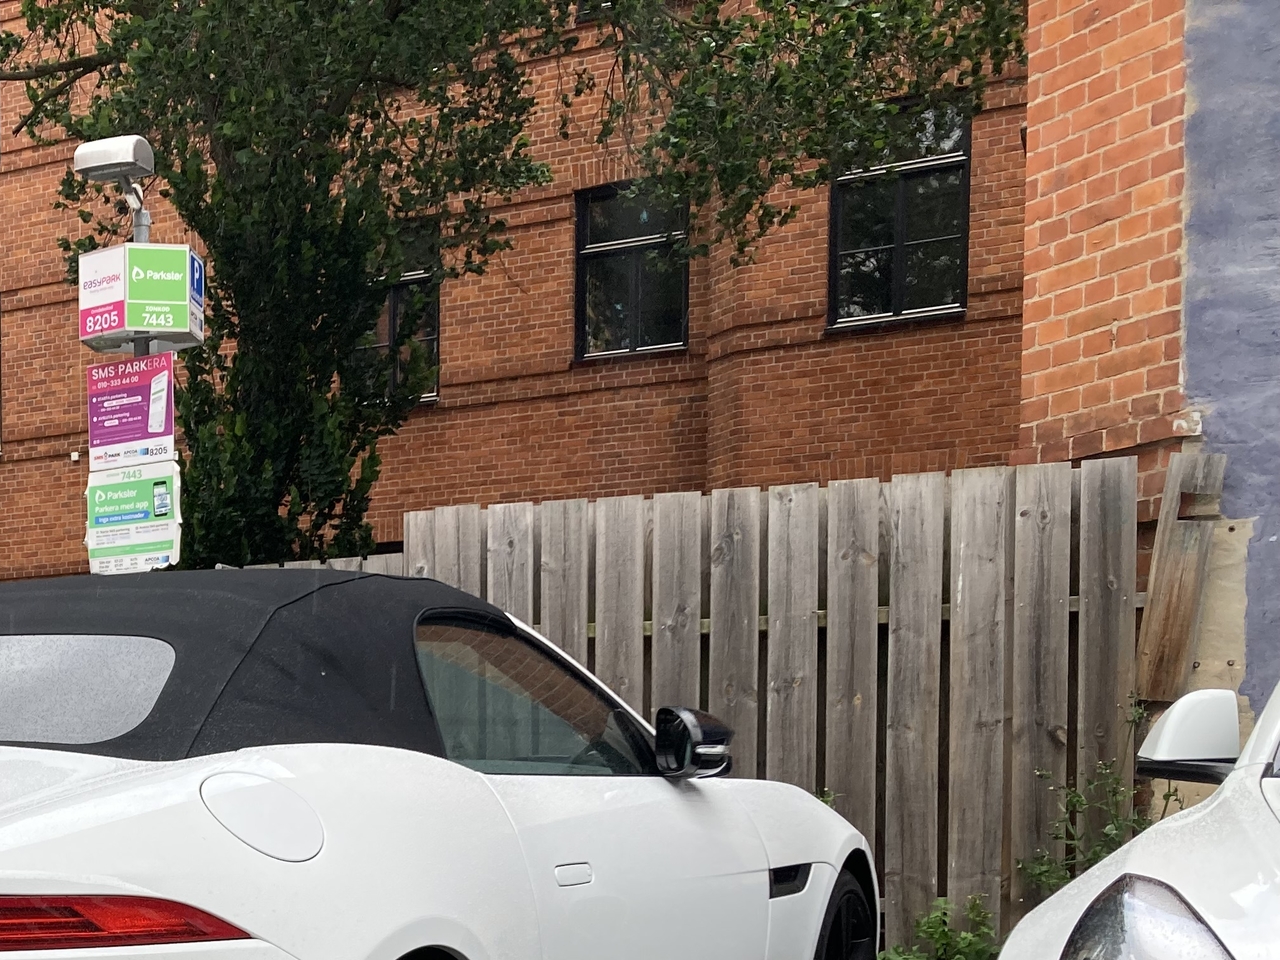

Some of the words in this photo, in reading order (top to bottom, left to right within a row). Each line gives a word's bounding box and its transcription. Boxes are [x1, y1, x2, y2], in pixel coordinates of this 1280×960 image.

[146, 270, 183, 281] Parkster
[86, 311, 119, 333] 8205
[142, 313, 174, 327] 7443
[122, 377, 130, 385] 44
[149, 446, 168, 456] 8205
[121, 470, 142, 481] 7443
[108, 489, 137, 500] Parkster
[95, 505, 119, 513] Parkera
[120, 502, 134, 510] med
[135, 501, 149, 509] app
